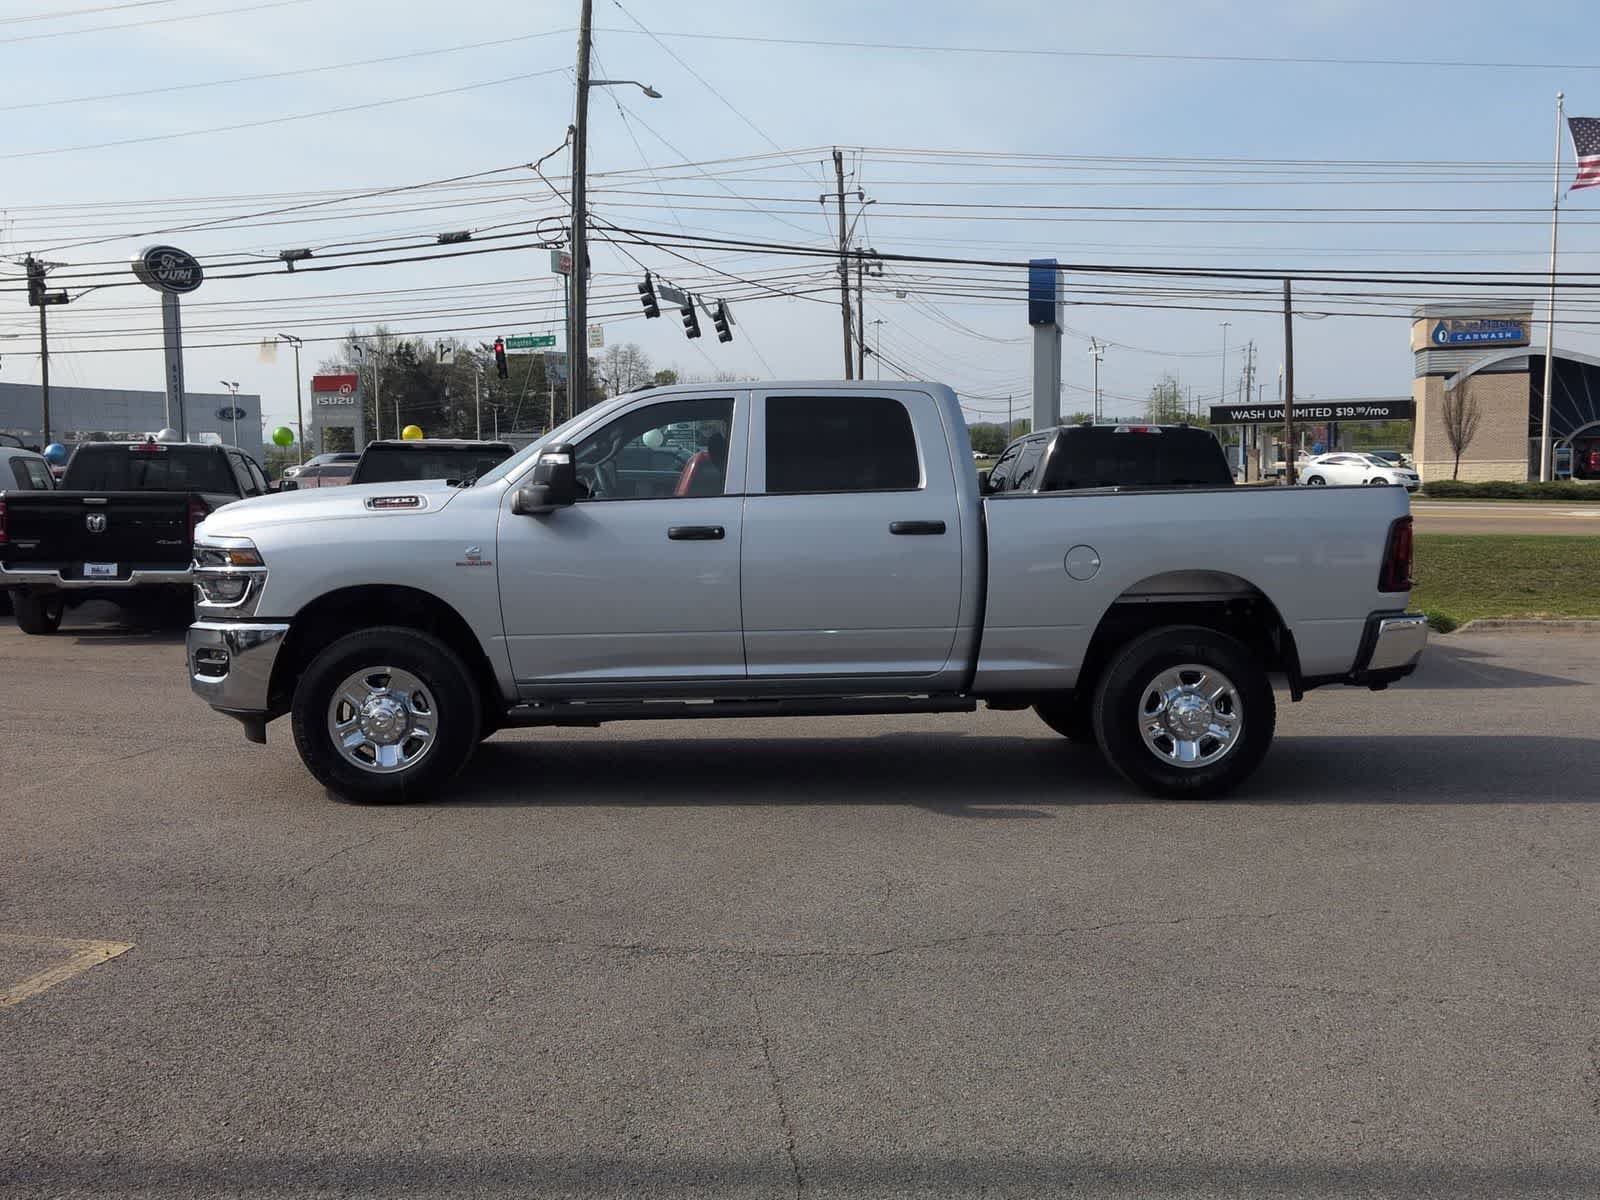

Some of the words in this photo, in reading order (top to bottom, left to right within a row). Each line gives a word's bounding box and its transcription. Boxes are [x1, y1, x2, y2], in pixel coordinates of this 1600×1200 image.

[158, 254, 193, 280] Ford
[1456, 331, 1512, 341] CARWASH
[316, 396, 355, 406] ISUZU
[1230, 409, 1266, 420] WASH
[1268, 406, 1332, 418] UNIMITED
